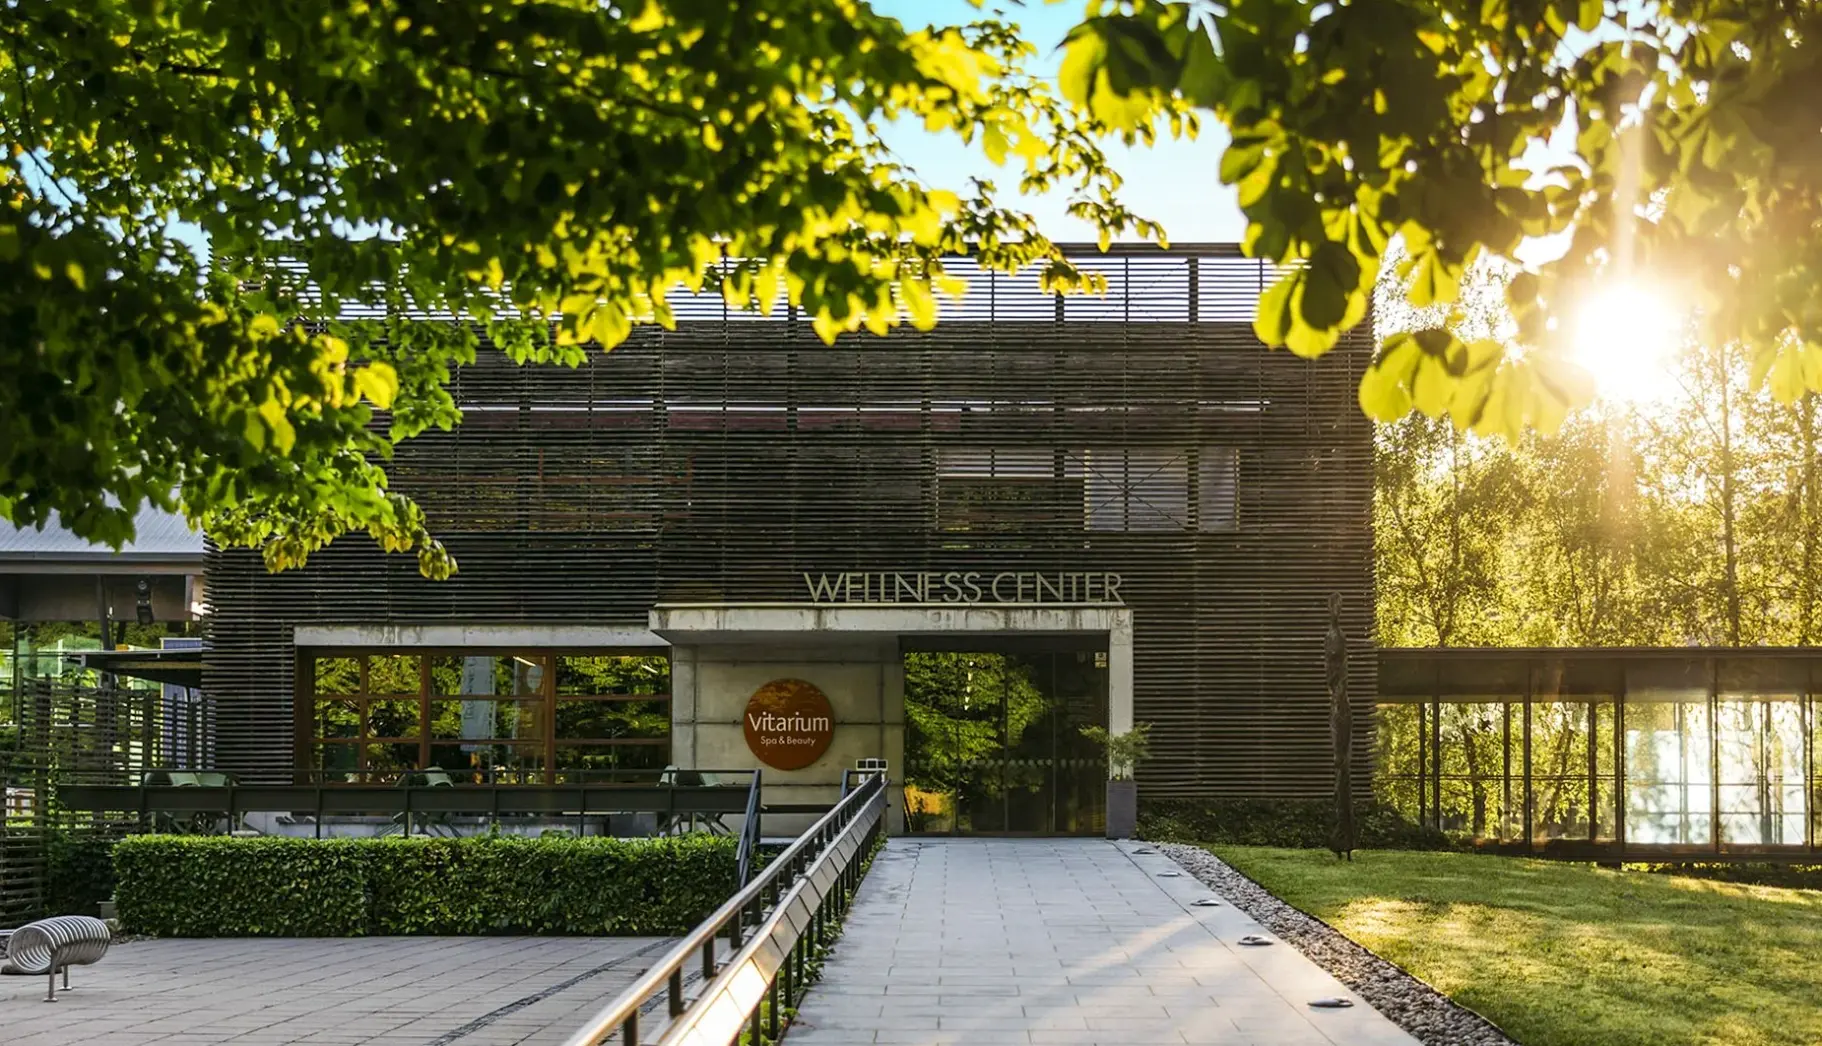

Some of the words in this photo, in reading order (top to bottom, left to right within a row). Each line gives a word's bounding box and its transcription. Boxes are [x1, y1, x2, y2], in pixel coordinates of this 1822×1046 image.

[803, 572, 982, 603] WELLNESS
[991, 572, 1125, 604] CENTER
[760, 735, 777, 747] Spa
[778, 735, 785, 745] &
[786, 735, 816, 747] Beauty
